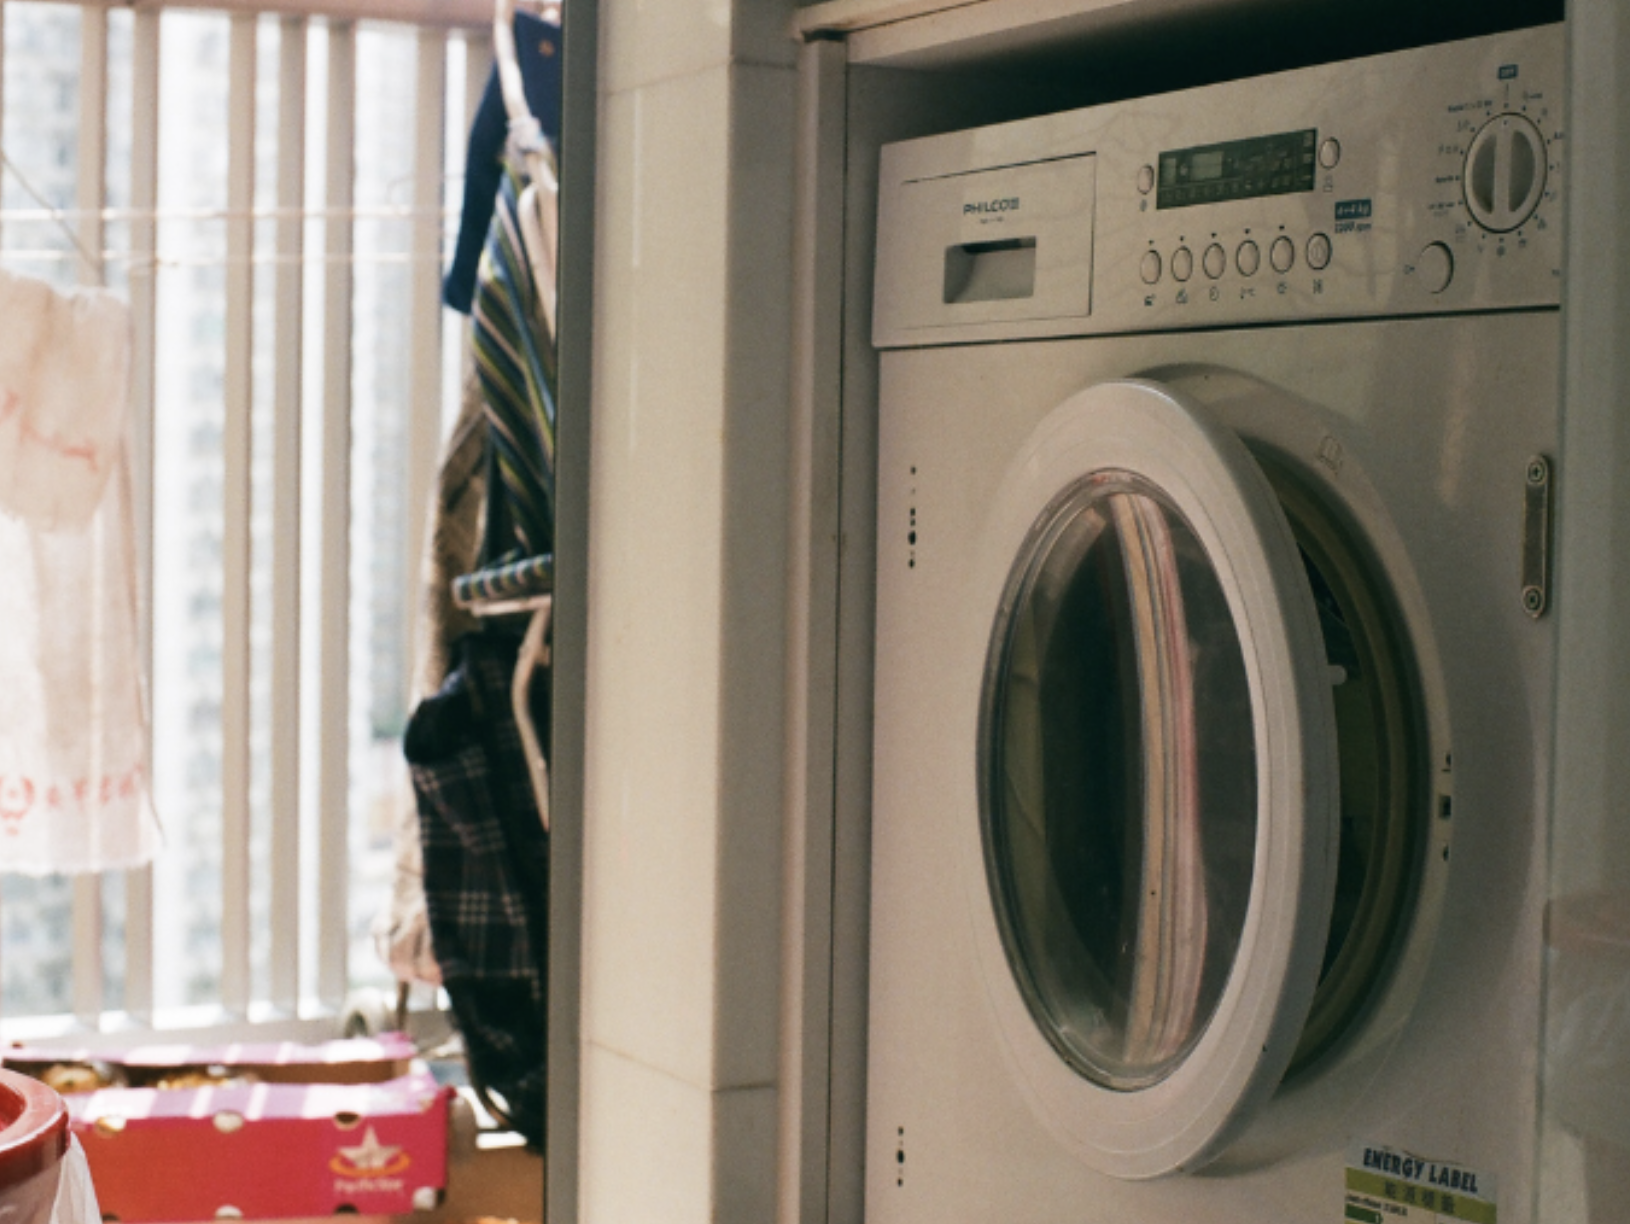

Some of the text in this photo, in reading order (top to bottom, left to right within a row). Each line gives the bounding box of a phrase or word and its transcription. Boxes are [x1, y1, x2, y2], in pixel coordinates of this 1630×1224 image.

[963, 198, 1010, 216] PHILCO
[1363, 1148, 1478, 1193] ENERGY LABEL
